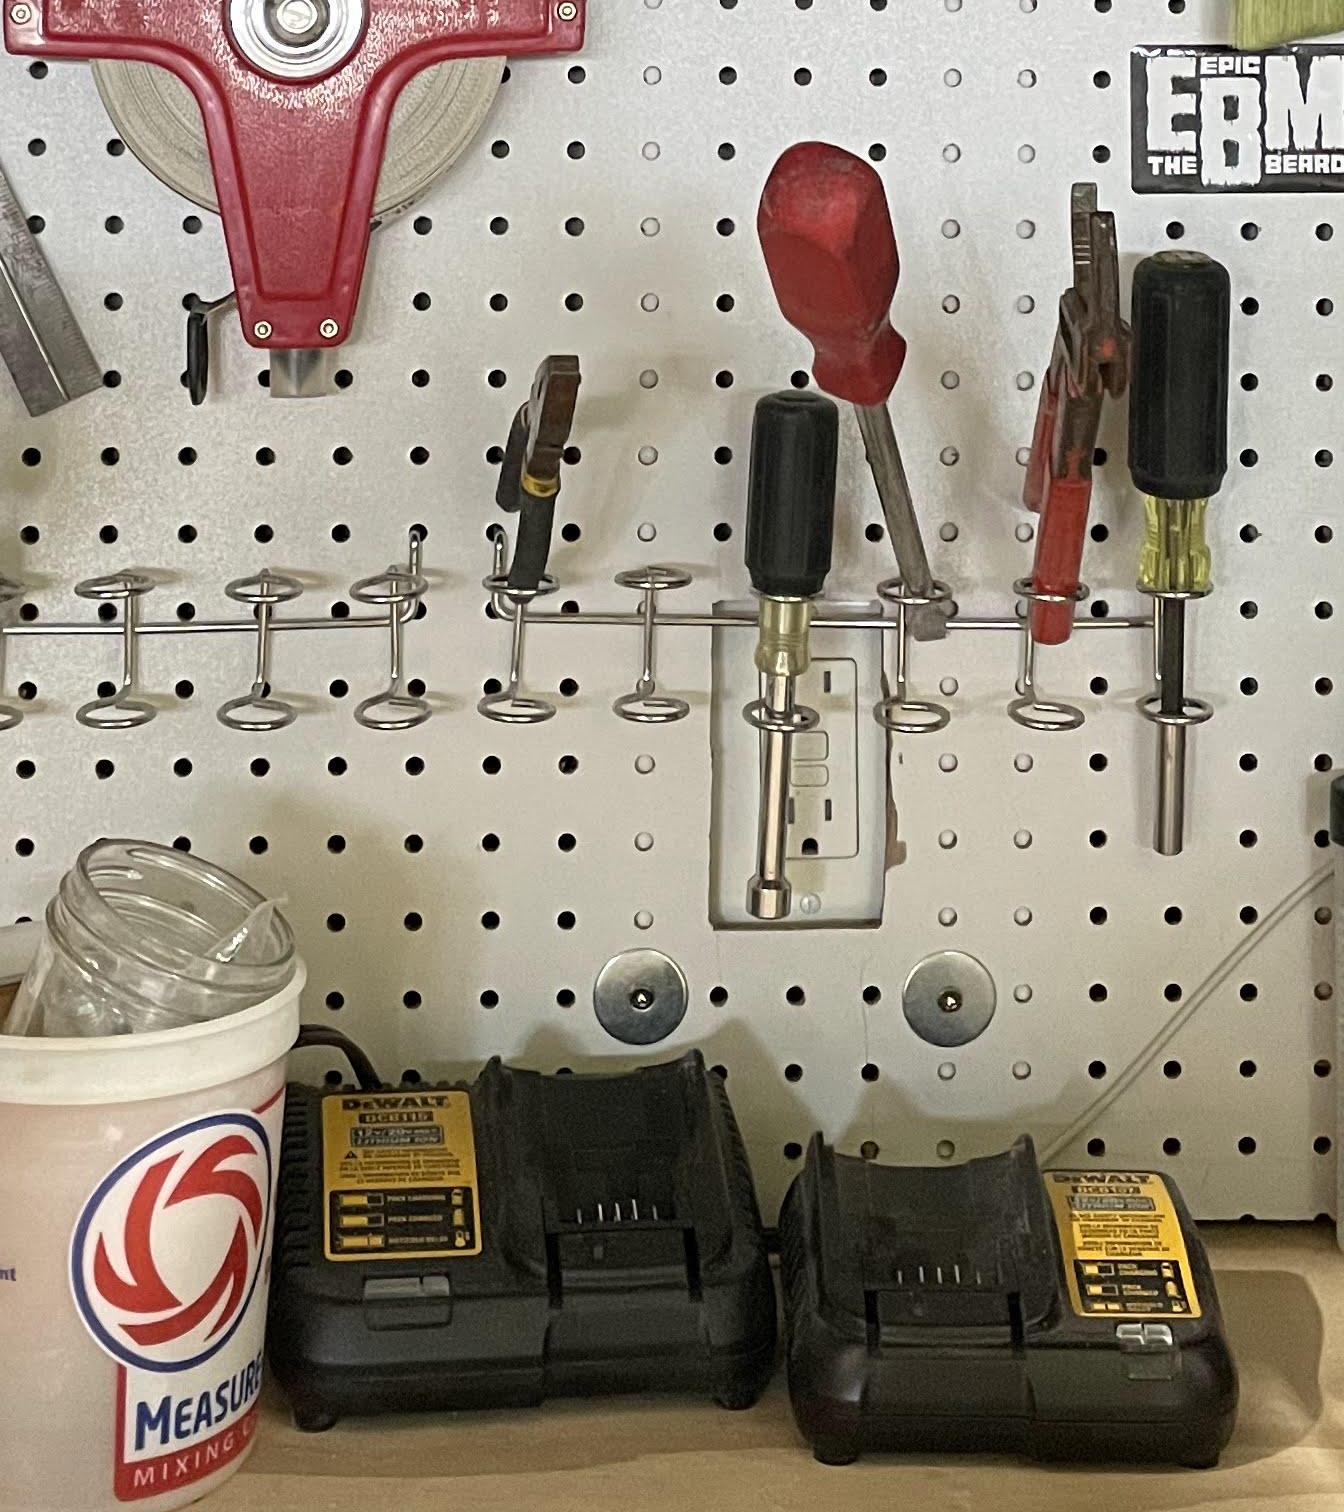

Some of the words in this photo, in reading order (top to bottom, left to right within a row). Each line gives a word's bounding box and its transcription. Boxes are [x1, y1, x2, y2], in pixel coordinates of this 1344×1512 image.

[1199, 56, 1261, 75] EPIC
[1147, 155, 1197, 175] THE
[133, 1432, 235, 1488] MIXING
